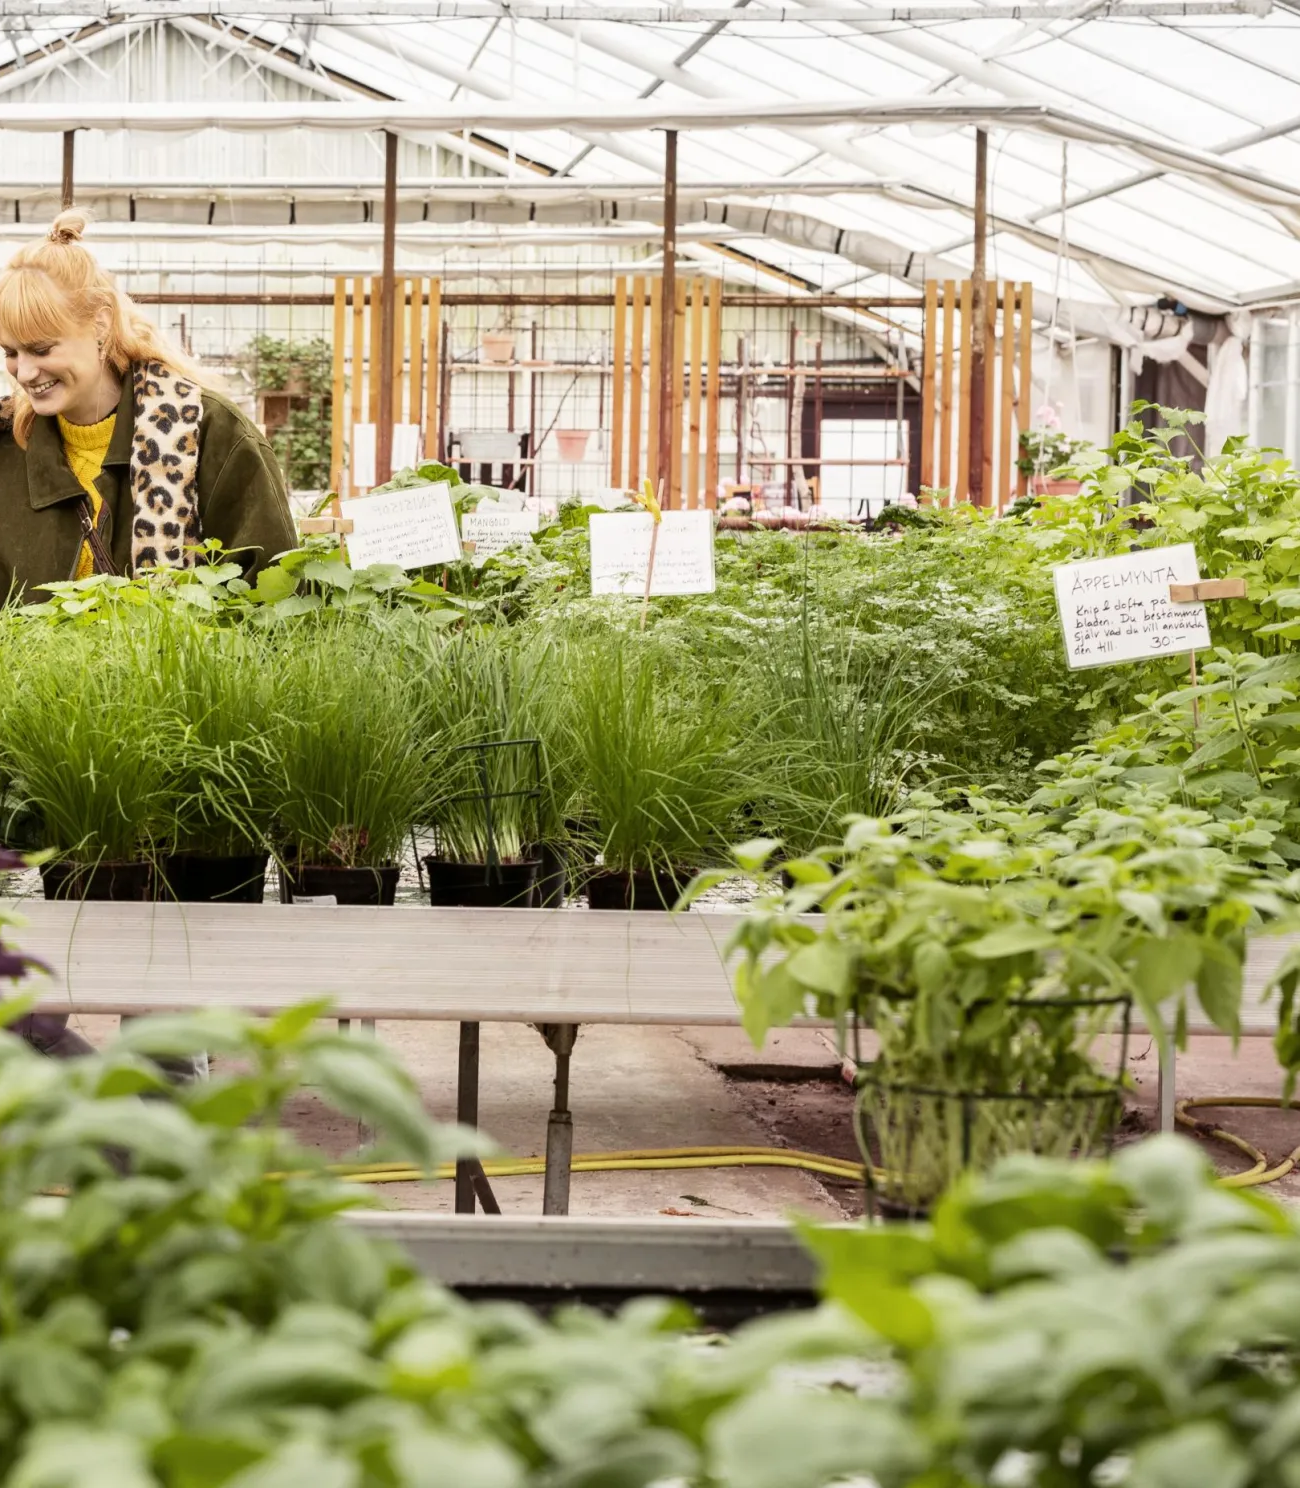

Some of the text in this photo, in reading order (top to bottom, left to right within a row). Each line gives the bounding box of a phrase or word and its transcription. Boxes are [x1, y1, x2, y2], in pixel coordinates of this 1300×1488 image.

[470, 517, 510, 527] MANGOLD
[1071, 566, 1178, 595] ÄPPELMYNTA
[1076, 604, 1099, 619] Knip
[1115, 597, 1144, 614] dofta
[1120, 613, 1136, 624] Du
[1144, 607, 1203, 622] bestämmer
[1105, 626, 1121, 637] vad
[1126, 626, 1139, 636] du
[1142, 622, 1158, 633] vill
[1162, 618, 1205, 631] använda
[1074, 645, 1091, 656] den
